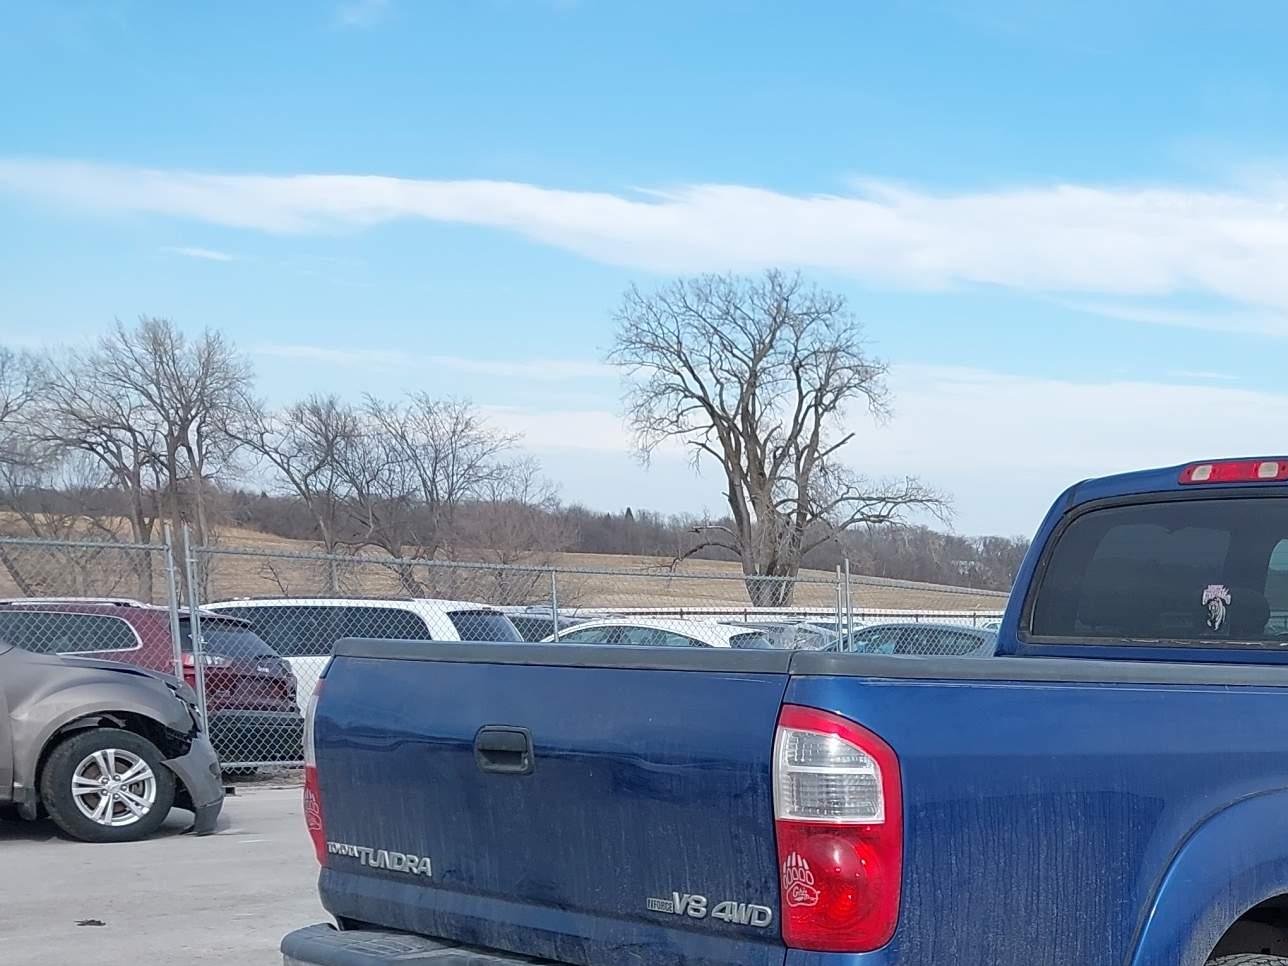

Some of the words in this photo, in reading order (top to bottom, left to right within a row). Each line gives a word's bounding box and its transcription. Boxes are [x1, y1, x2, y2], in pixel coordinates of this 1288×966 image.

[358, 847, 433, 877] TUNDRA
[673, 891, 708, 918] V8
[711, 901, 772, 927] 4WD
